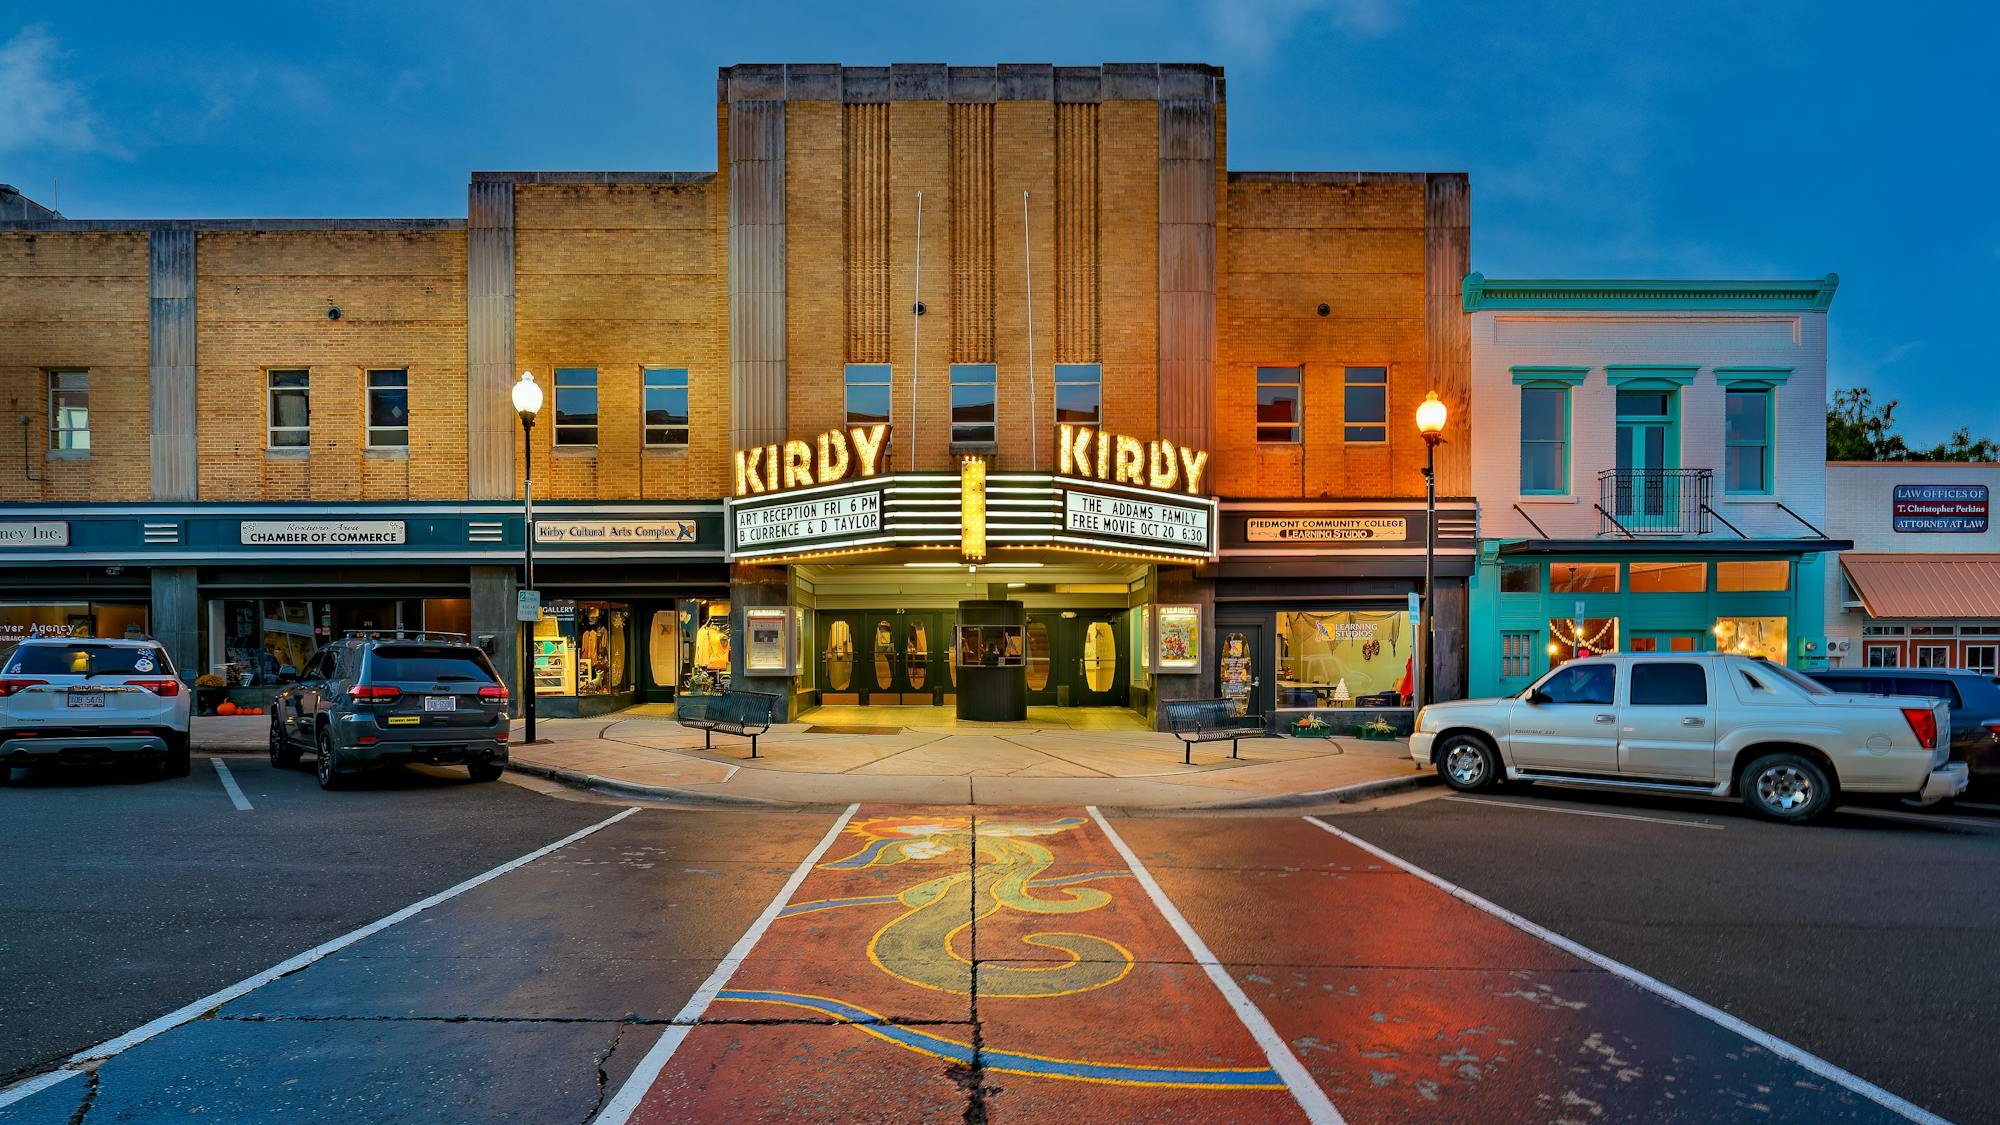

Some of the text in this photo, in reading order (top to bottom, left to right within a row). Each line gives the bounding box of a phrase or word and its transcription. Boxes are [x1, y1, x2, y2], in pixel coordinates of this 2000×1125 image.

[1898, 489, 1985, 498] LAW OFFICES OF
[740, 496, 878, 527] ART RECEPTION FRI 6 PM
[1082, 498, 1197, 526] THE ADDAMS FAMILY
[1897, 504, 1985, 515] T. Christopher Perkins
[739, 514, 878, 542] B CURRENCE & D TAYLOR
[1072, 514, 1203, 542] FREE MOVIE OCT 20 6:30
[1250, 520, 1404, 528] PIEDMONT COMMUNITY COLLEGE
[1897, 520, 1985, 528] ATTORNEY AT LAW
[32, 526, 62, 539] Inc.
[250, 533, 397, 542] CHAMBER OF COMMERCE
[540, 526, 676, 540] Kirby Cultural Arts Complex
[1286, 529, 1368, 539] LEARNING STUDIO
[30, 622, 75, 635] Agency
